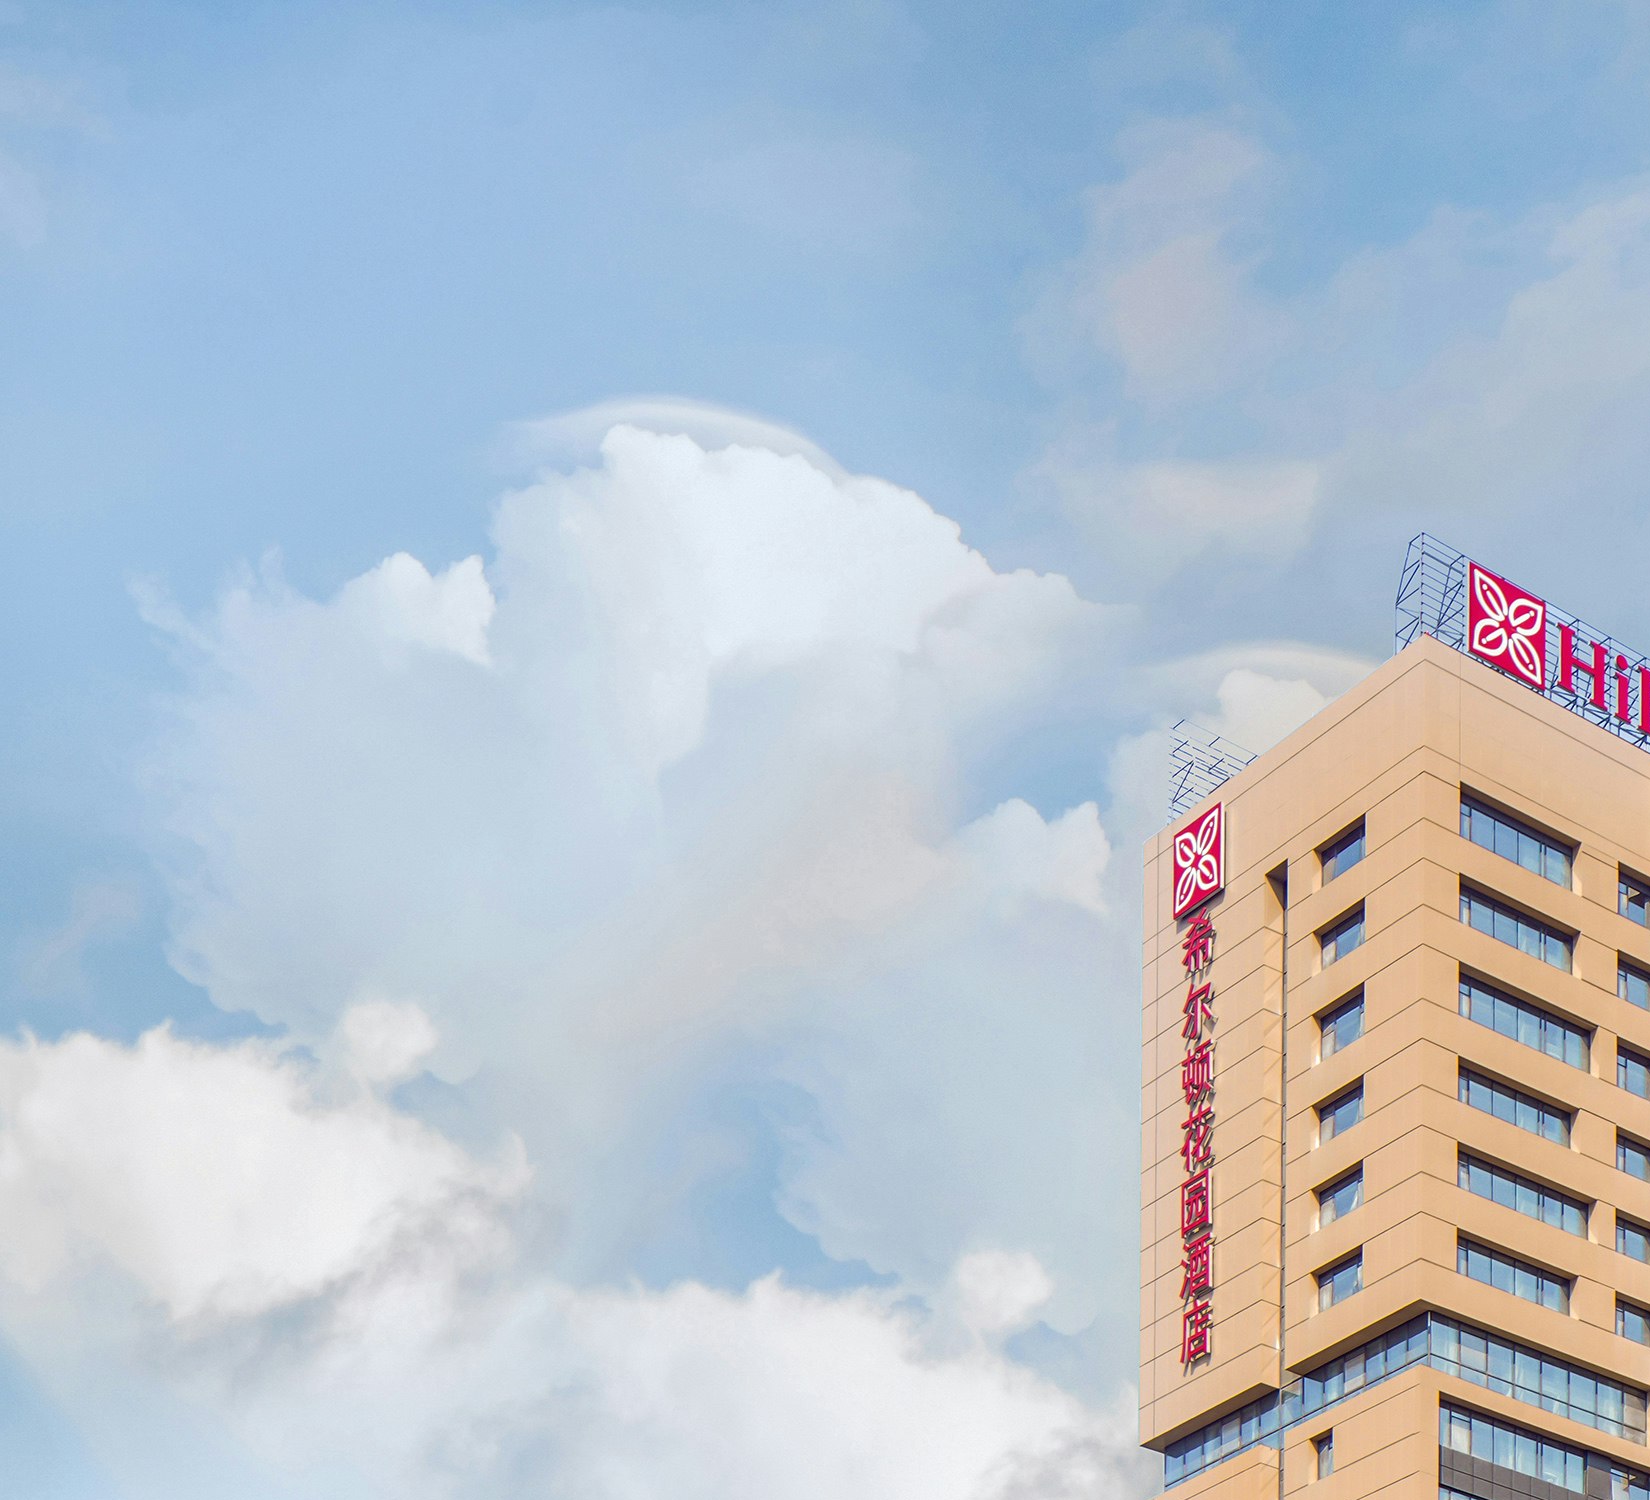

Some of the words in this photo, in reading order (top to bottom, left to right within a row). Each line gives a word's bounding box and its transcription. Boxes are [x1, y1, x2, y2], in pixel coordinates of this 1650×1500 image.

[1180, 906, 1216, 1364] 希尔顿花园酒店
